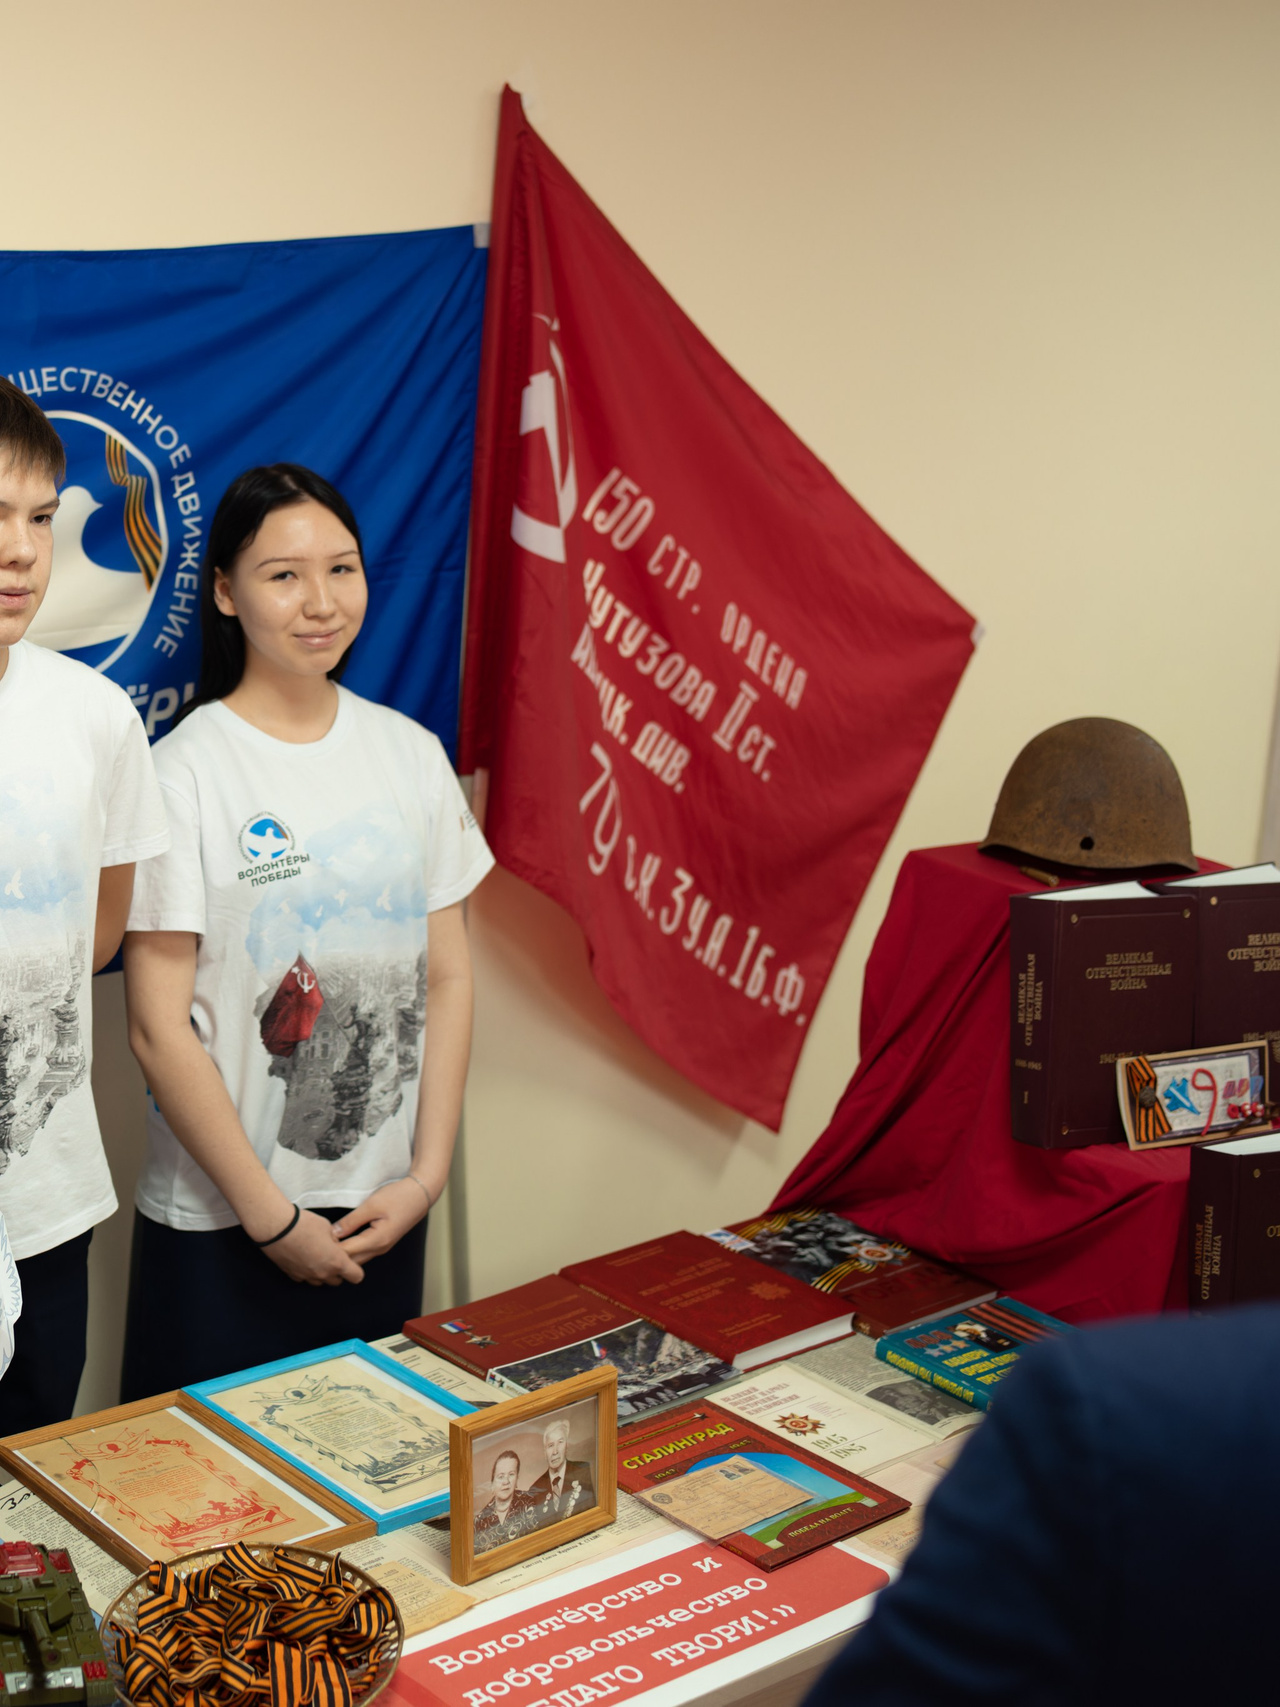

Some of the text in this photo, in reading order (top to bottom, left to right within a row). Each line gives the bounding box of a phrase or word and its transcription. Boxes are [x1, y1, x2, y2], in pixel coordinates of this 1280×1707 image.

[153, 471, 203, 658] ДВИЖЕНИЕ
[581, 465, 656, 551] 150
[647, 533, 702, 615] СТР.
[720, 601, 808, 710] ОРДЕНА
[237, 853, 311, 880] ВОЛОНТЁРЫ
[251, 867, 302, 887] ПОБЕДЫ
[1085, 963, 1172, 979] ОТЕЧЕСТВЕННАЯ
[1105, 951, 1154, 965] ВЕЛИКАЯ
[1018, 973, 1026, 1024] ВЕЛИКАЯ
[1025, 953, 1035, 1046] ОТЕЧЕСТВЕННАЯ
[1034, 980, 1043, 1021] ВОЙНА
[1110, 977, 1148, 991] ВОЙНА
[1194, 1222, 1204, 1276] ВЕЛИКАЯ
[1201, 1204, 1214, 1300] ОТЕЧЕСТВЕННАЯ
[1211, 1234, 1222, 1275] ВОЙНА
[622, 1423, 736, 1470] СТАЛИНГРАД
[811, 1433, 848, 1450] 1945
[830, 1443, 867, 1459] 1985
[788, 1522, 821, 1538] ПОБЕДА
[428, 1571, 683, 1676] Волонтёрство
[692, 1556, 723, 1574] и
[651, 1603, 797, 1668] ТВОРИ!»
[462, 1577, 769, 1707] добровольчество
